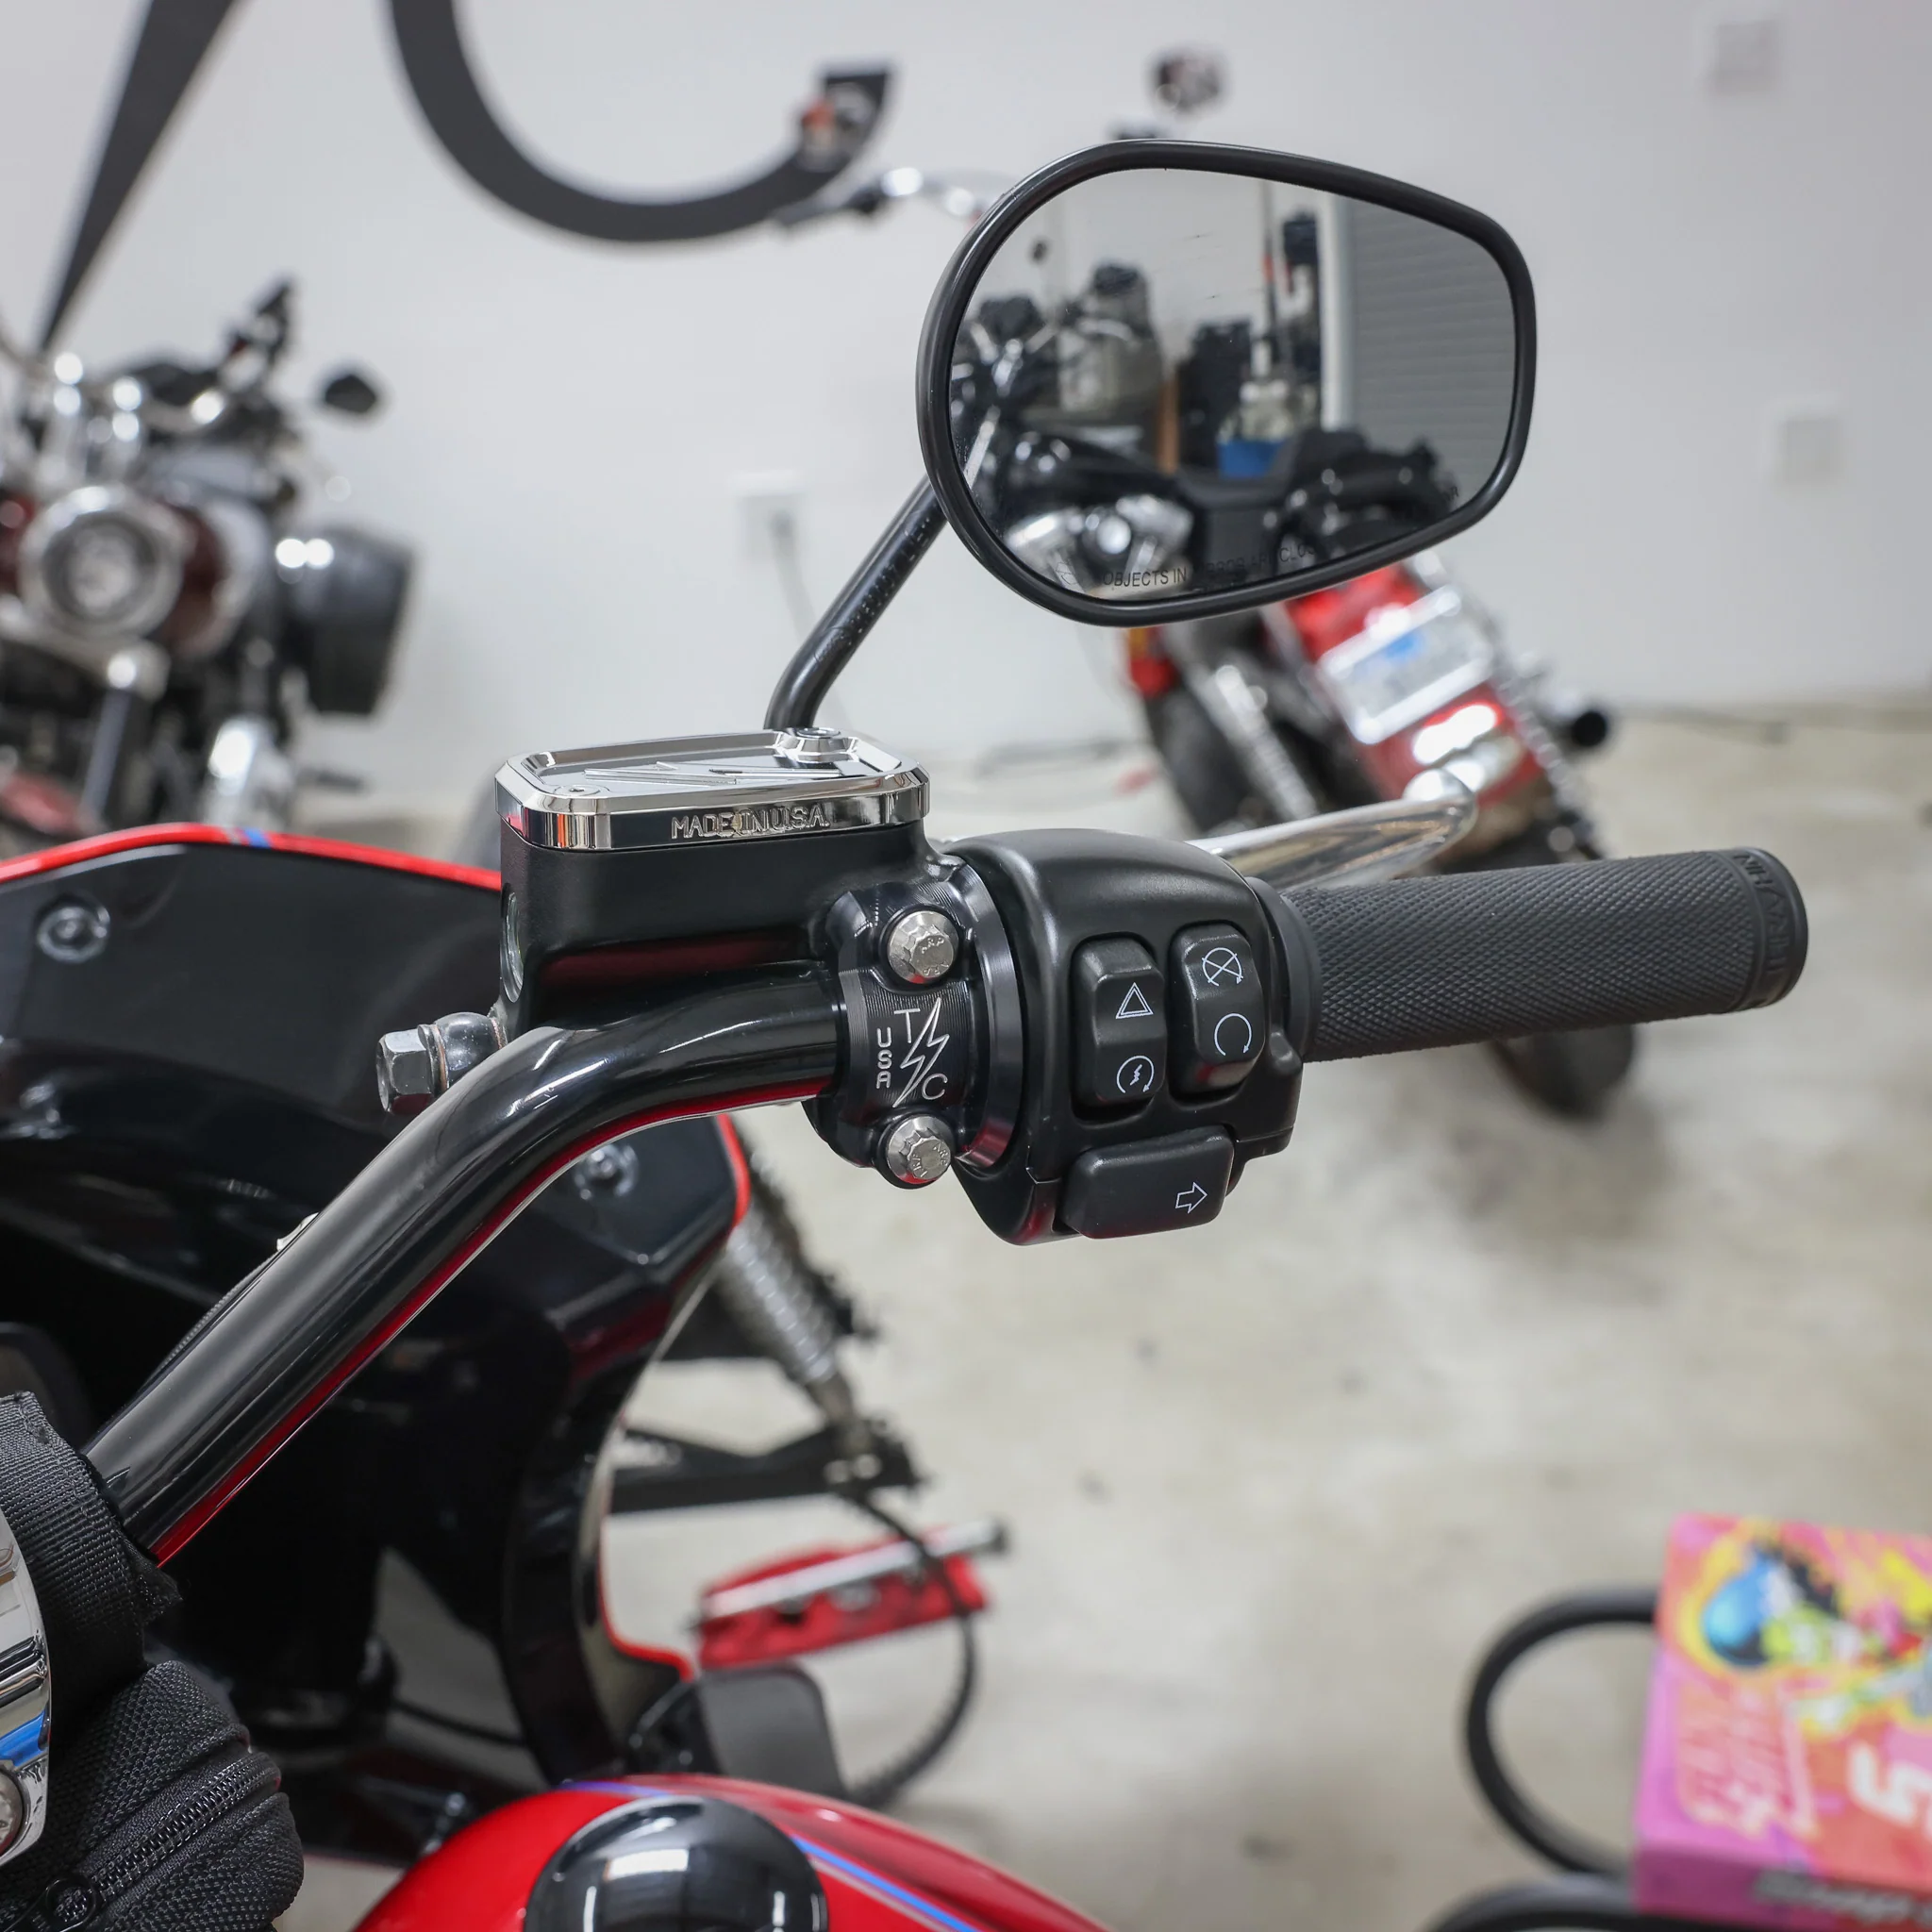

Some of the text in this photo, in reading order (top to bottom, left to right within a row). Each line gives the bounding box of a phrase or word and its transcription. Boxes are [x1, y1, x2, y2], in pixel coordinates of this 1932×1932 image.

[1103, 570, 1169, 588] OBJECTS
[1173, 567, 1187, 584] IN
[671, 812, 734, 840] MADE
[739, 808, 770, 835] IN
[875, 1026, 892, 1090] USA
